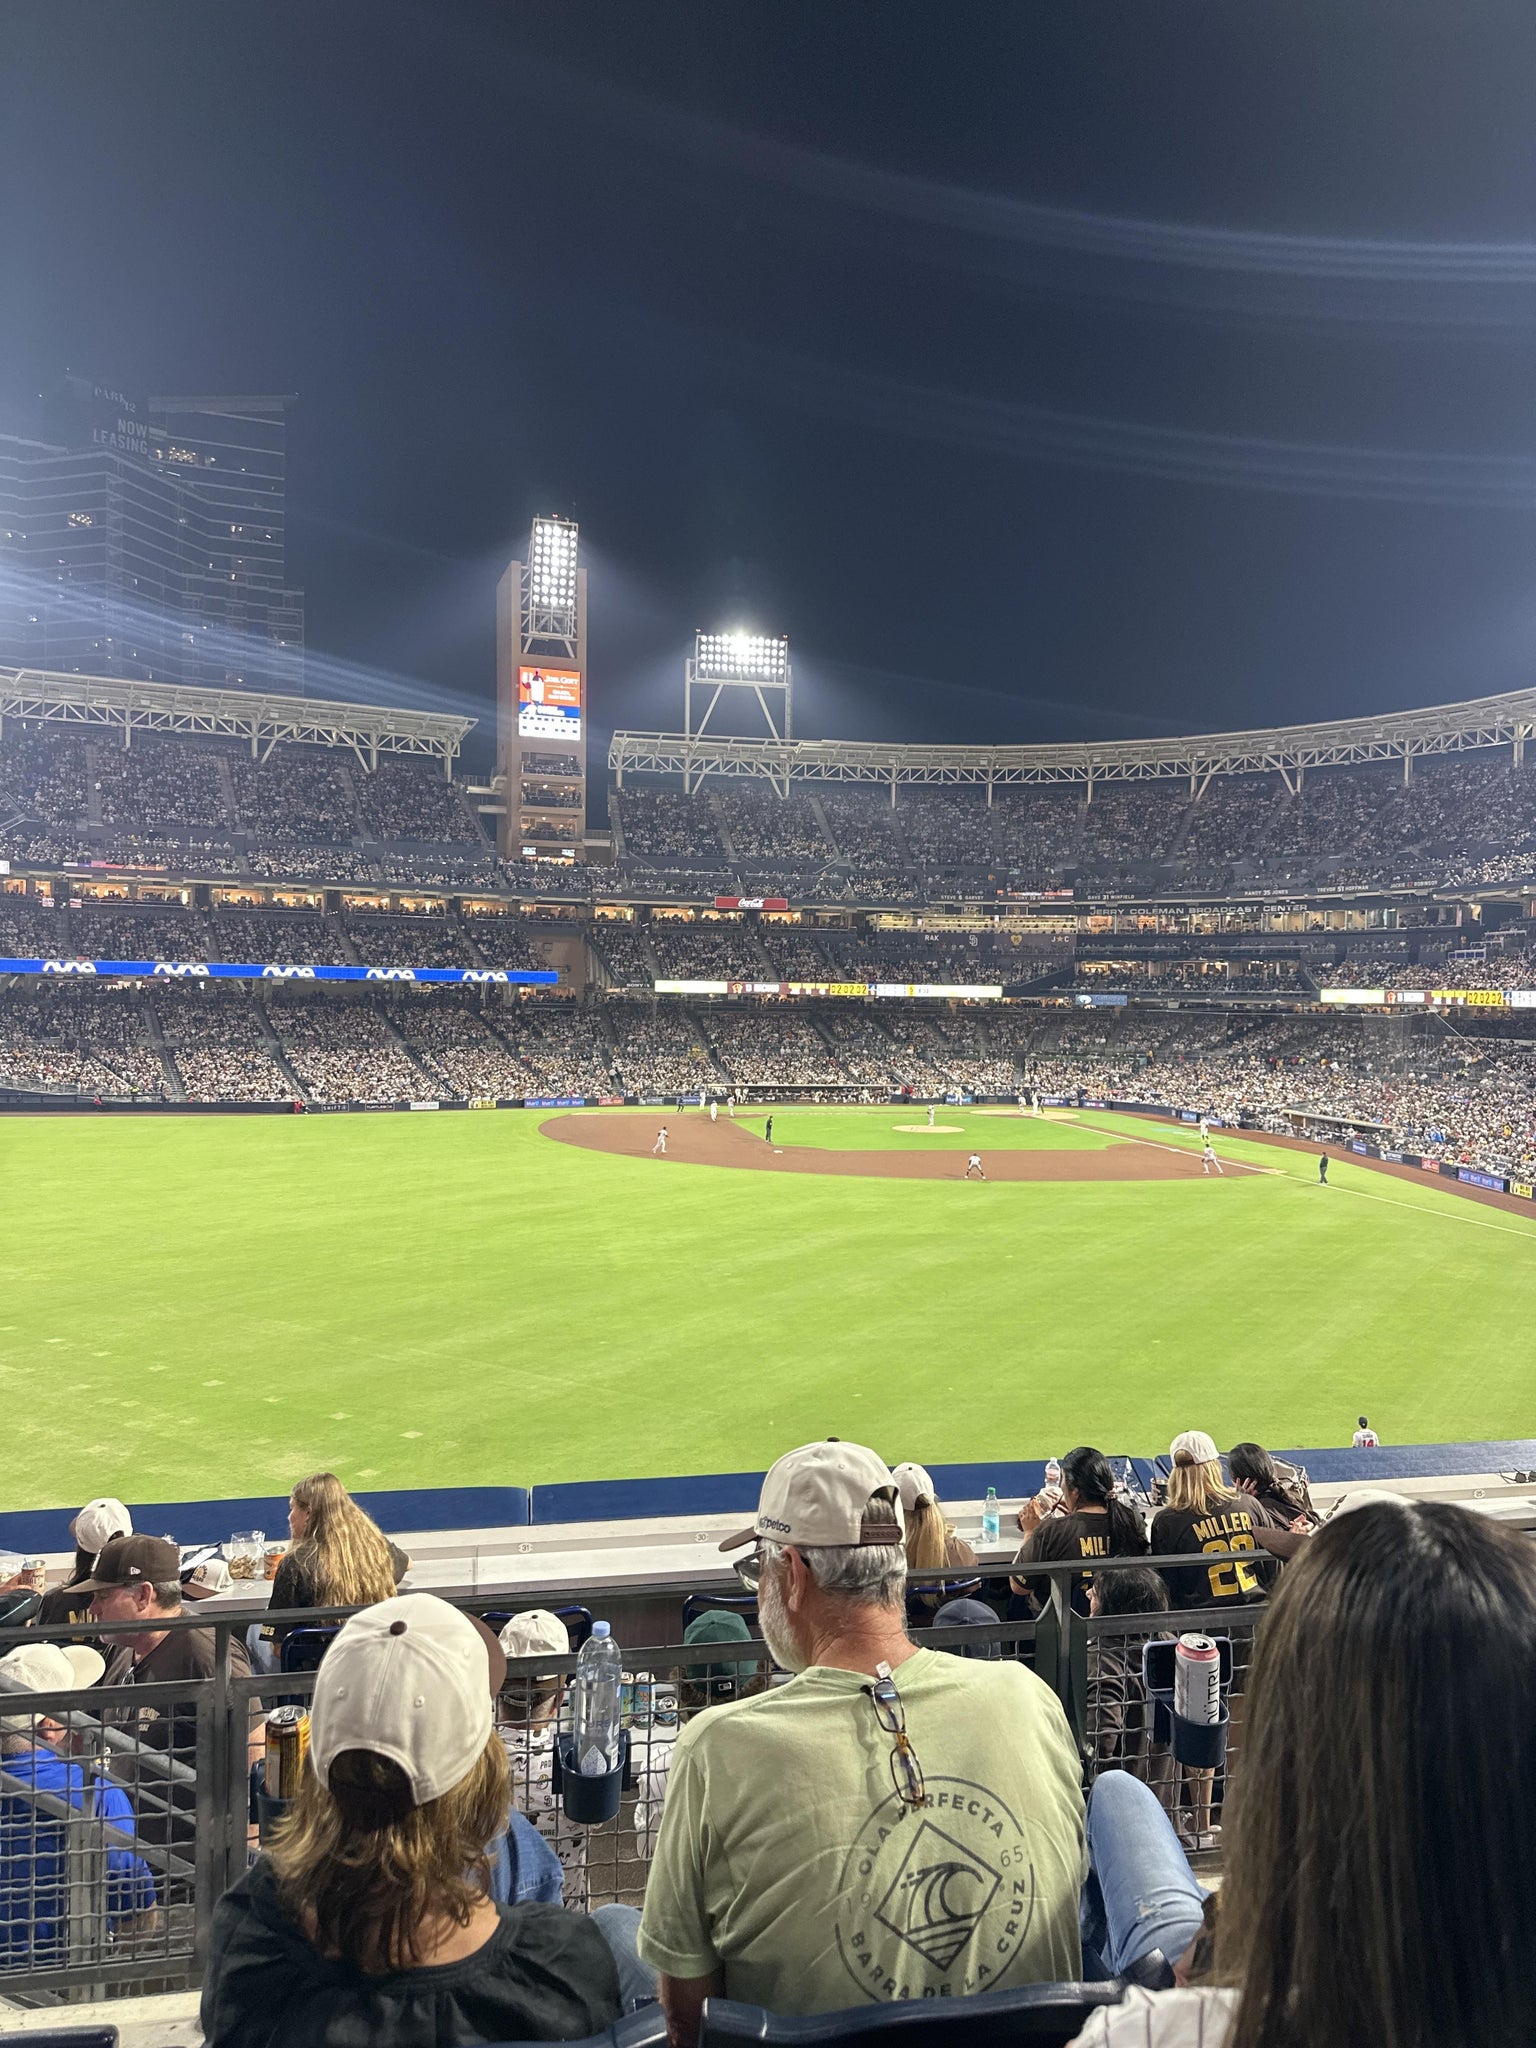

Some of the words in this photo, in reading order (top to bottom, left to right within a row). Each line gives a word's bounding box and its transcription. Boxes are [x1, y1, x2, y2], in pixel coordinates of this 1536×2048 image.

[118, 419, 148, 439] NOW
[93, 428, 148, 455] LEASING
[1089, 906, 1125, 915] JERRY
[1129, 907, 1184, 915] COLEMAN
[1188, 905, 1259, 914] BROADCAST
[1262, 904, 1308, 912] CENTER
[924, 934, 939, 942] RAK
[766, 1519, 791, 1534] petco
[1192, 1511, 1252, 1541] MILLER
[858, 1826, 891, 1876] OLA
[896, 1792, 1003, 1838] PERFECTA
[1000, 1845, 1024, 1867] 65
[851, 1931, 911, 1999] BARRA
[923, 1984, 952, 1998] DE
[965, 1963, 992, 1990] LA
[996, 1878, 1026, 1953] CRUZ
